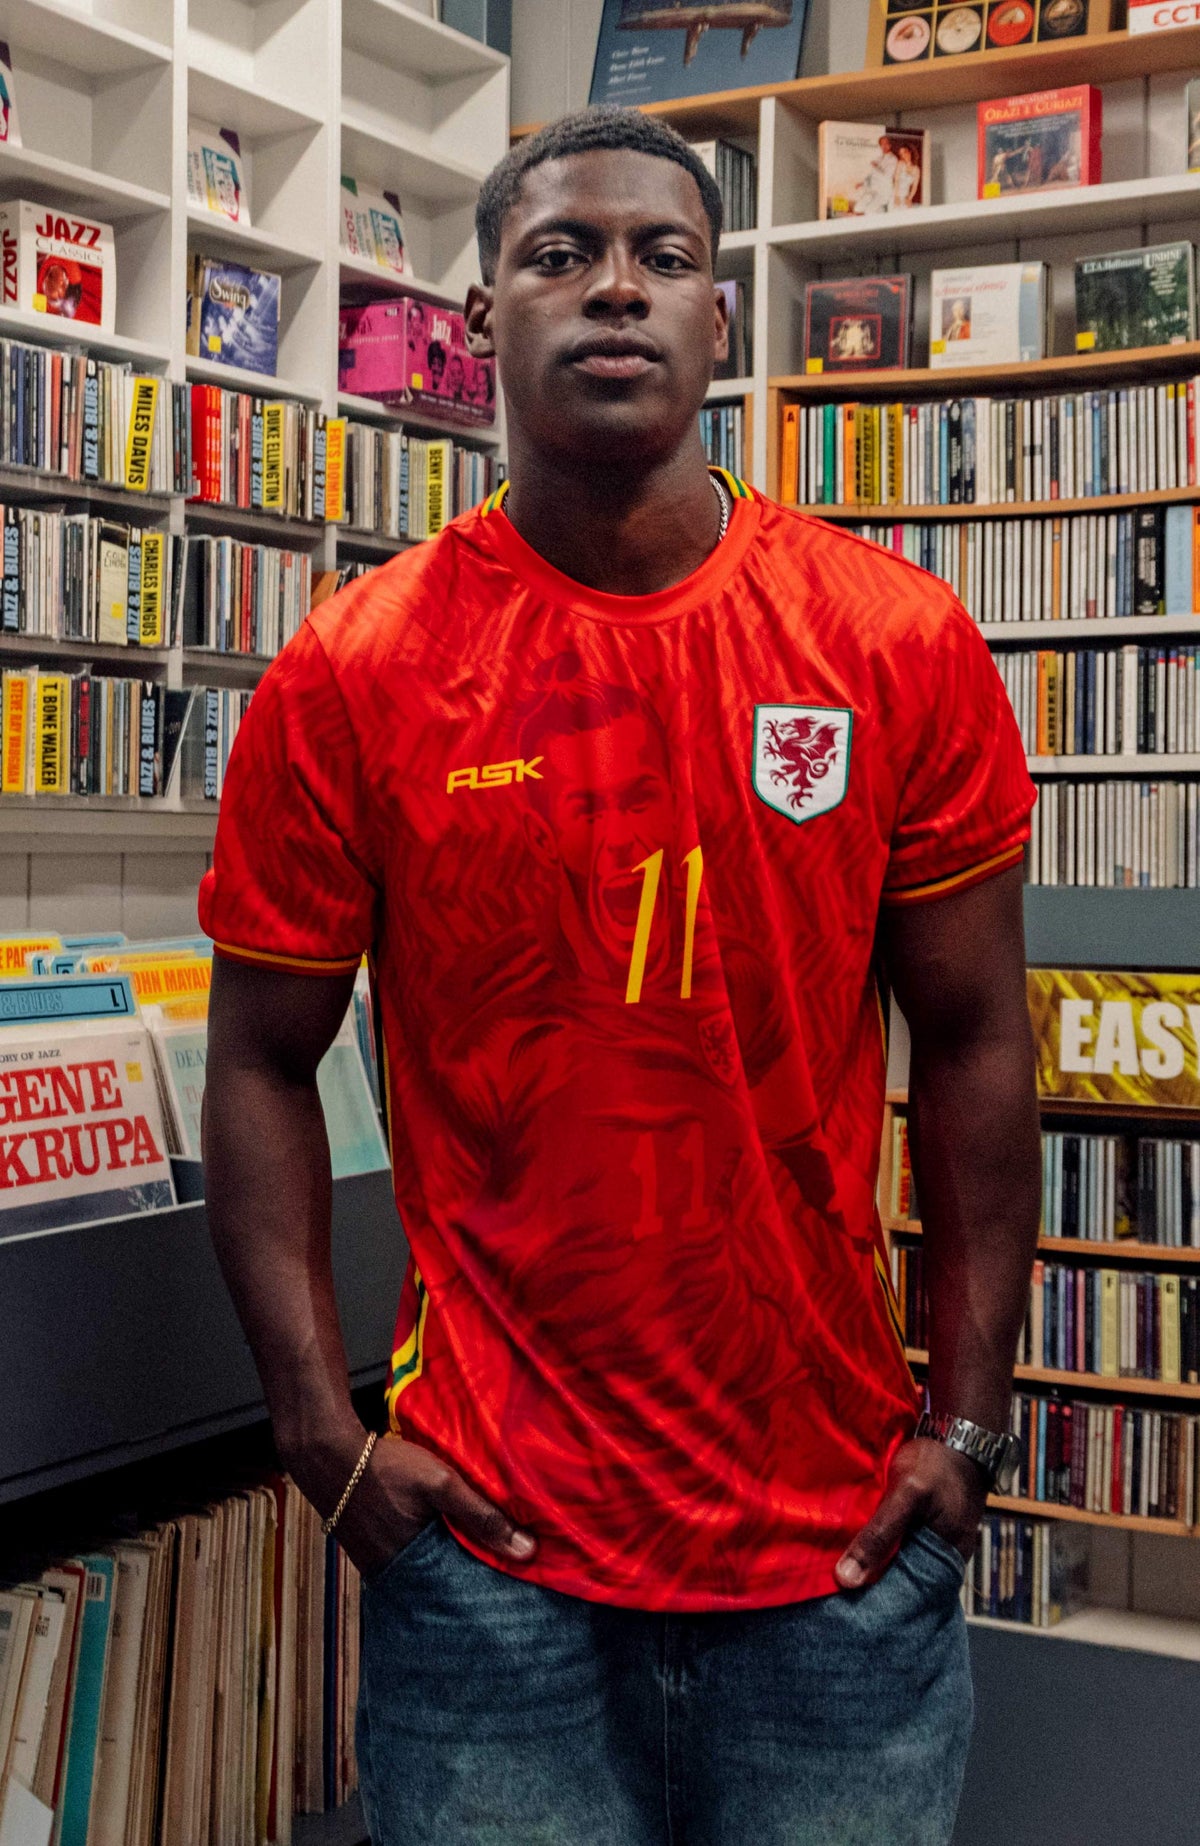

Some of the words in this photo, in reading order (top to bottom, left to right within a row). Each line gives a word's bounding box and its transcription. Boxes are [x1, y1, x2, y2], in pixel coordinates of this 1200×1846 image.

[36, 213, 102, 251] JAZZ
[36, 238, 104, 264] CLASSICS
[3, 229, 18, 303] JAZZ
[85, 377, 98, 426] BLUES
[134, 385, 154, 433] MILES
[266, 409, 281, 440] DUKE
[252, 415, 264, 459] BLUES
[315, 430, 326, 471] BLUES
[328, 427, 342, 459] FATS
[863, 413, 873, 498] BEETHOVEN
[128, 437, 149, 485] DAVIS
[265, 442, 281, 503] ELLINGTON
[429, 448, 442, 481] BENNY
[326, 462, 340, 516] DOMINO
[428, 484, 442, 534] GOODMAN
[5, 526, 19, 577] BLUES
[128, 545, 141, 592] BLUES
[143, 538, 159, 588] CHARLES
[5, 577, 19, 592] &
[4, 592, 19, 629] JAZZ
[142, 592, 158, 637] MINGUS
[10, 681, 24, 711] STEVE
[42, 696, 57, 730] BONE
[9, 714, 23, 733] RAY
[142, 699, 155, 745] BLUES
[7, 735, 22, 784] VAUGHAN
[41, 732, 57, 786] WALKER
[205, 747, 217, 797] BLUES
[446, 756, 544, 794] ASK
[625, 845, 704, 1004] 11
[20, 991, 64, 1014] BLUES
[20, 1051, 34, 1061] OF
[38, 1049, 62, 1060] JAZZ
[0, 1059, 123, 1126] GENE
[0, 1115, 164, 1190] KRUPA
[630, 1121, 709, 1242] 11
